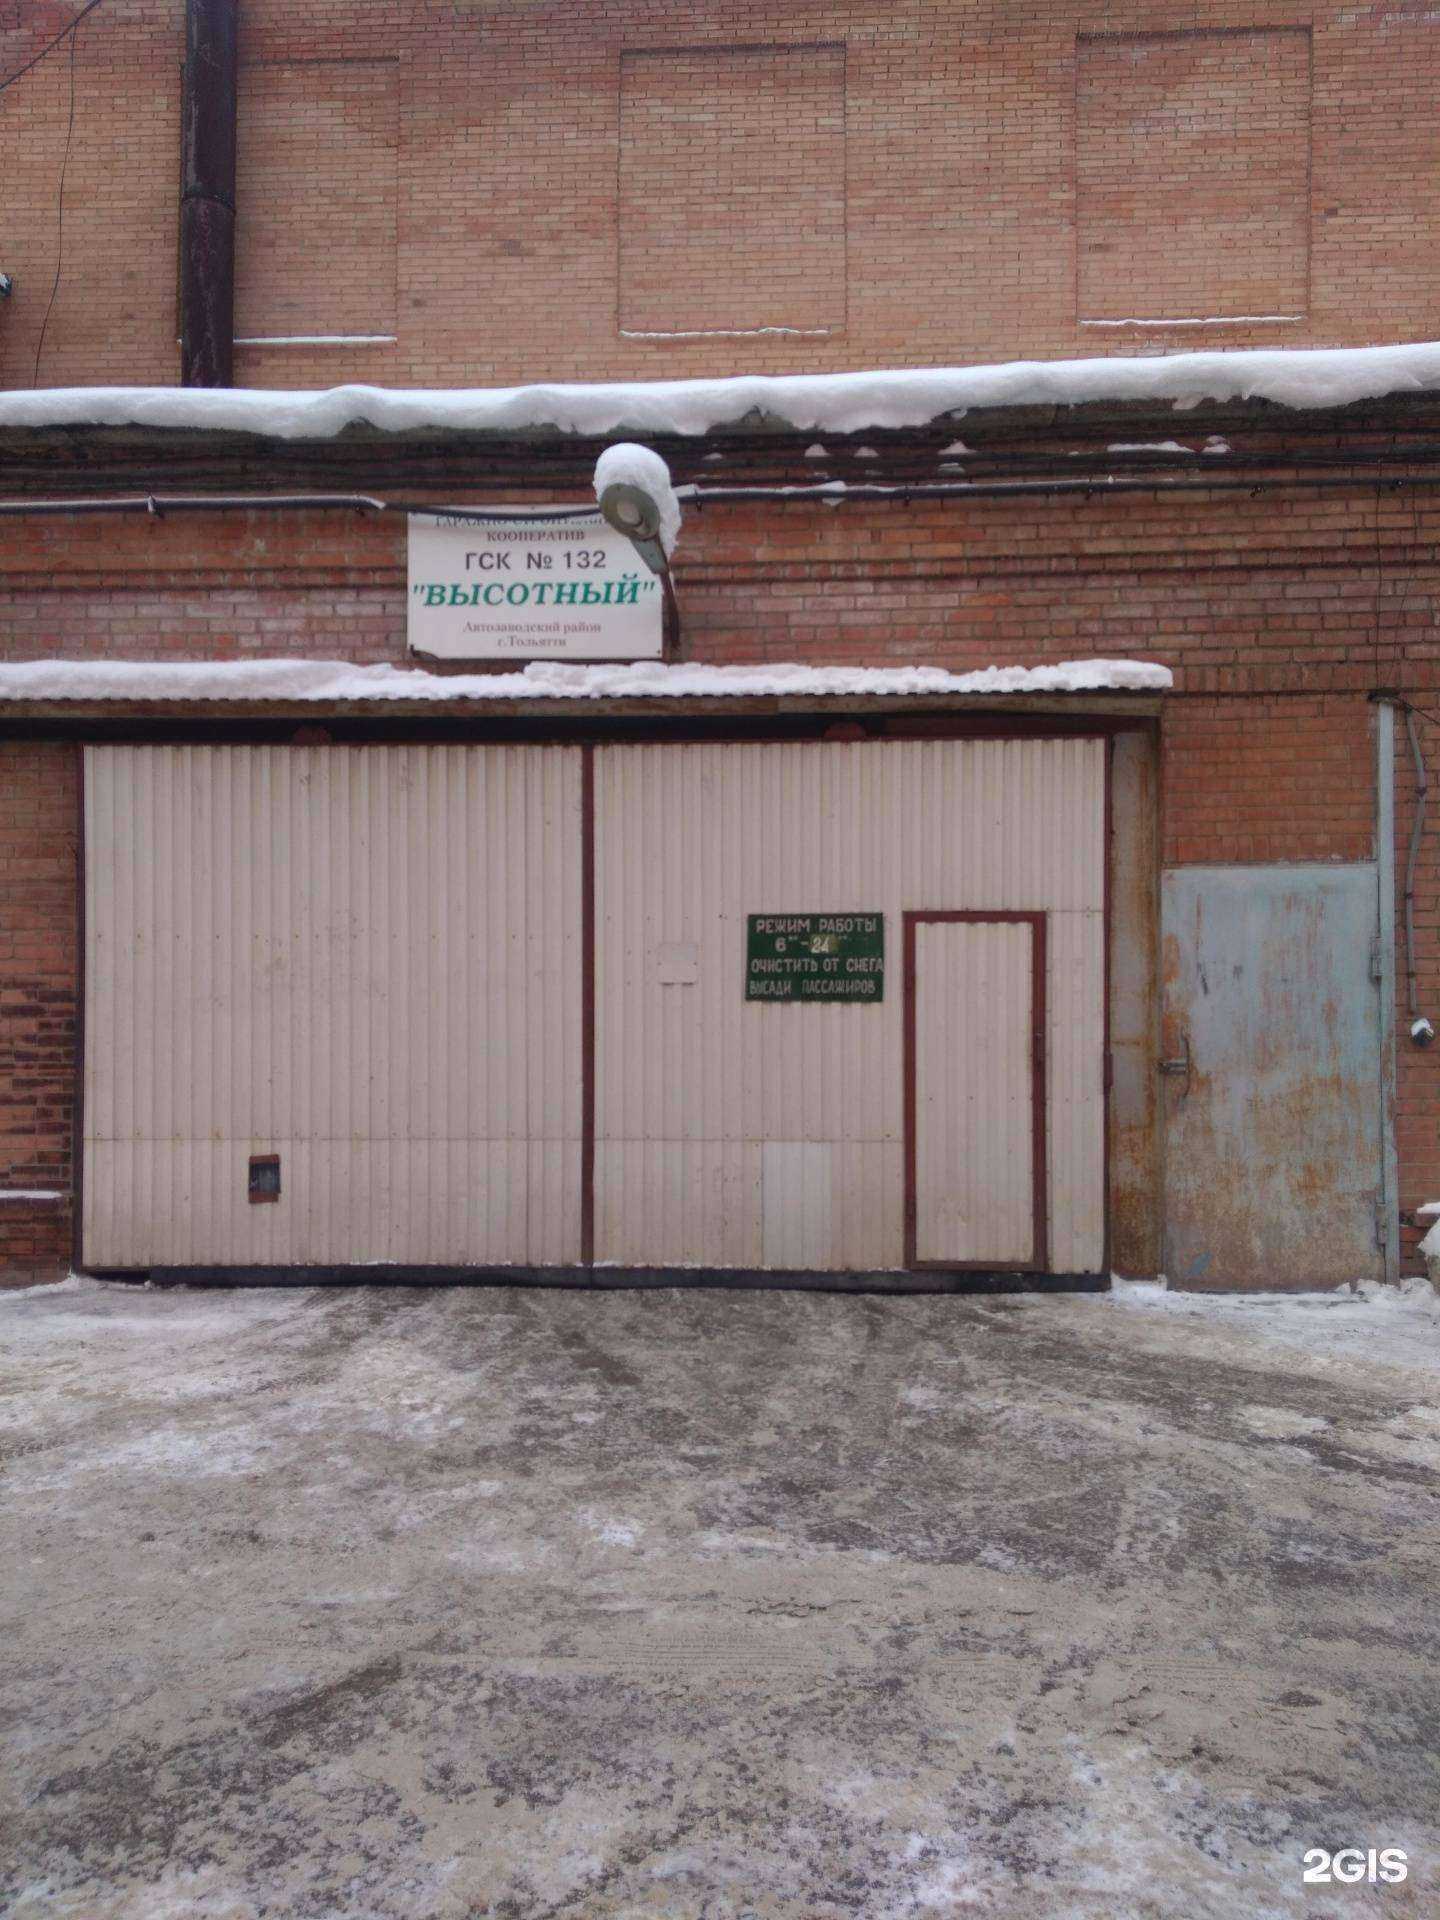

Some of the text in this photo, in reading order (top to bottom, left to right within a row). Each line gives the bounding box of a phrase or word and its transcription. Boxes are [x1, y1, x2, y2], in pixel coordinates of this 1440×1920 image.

[487, 531, 585, 542] КООПЕРАТИВ
[466, 551, 606, 570] ГСК № 132
[413, 574, 656, 606] "ВЫСОТНЫЙ"
[463, 621, 602, 635] Автозаводский район
[756, 918, 877, 933] РЕЖИМ РАБОТЫ
[751, 957, 884, 973] ОЧИСТИТЬ ОТ СНЕГА
[802, 979, 876, 994] ПАССАЖИРОВ
